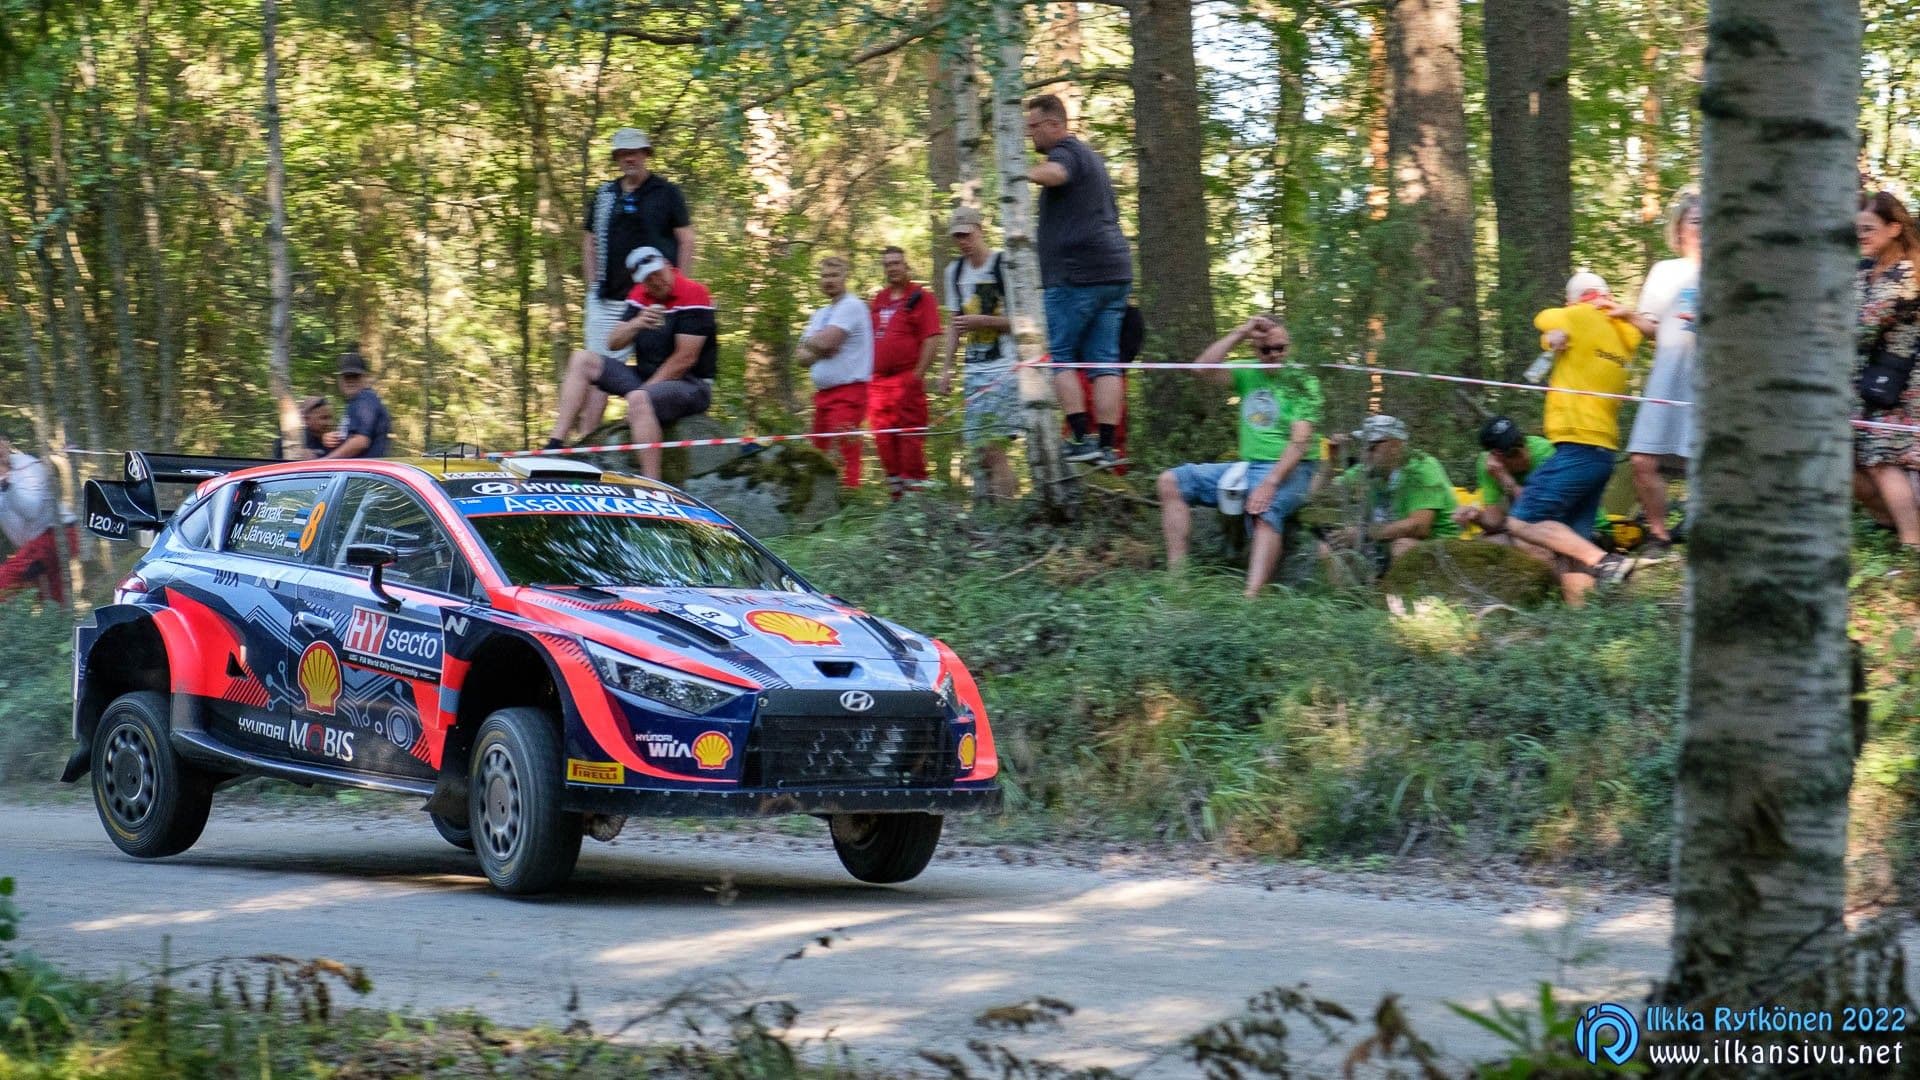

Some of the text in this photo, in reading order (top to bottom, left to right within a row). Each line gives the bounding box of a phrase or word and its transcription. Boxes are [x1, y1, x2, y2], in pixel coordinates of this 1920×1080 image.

[522, 482, 625, 498] HYUNDAI
[241, 500, 284, 521] O. Tänak
[230, 523, 285, 550] M. Järveoja
[299, 501, 327, 552] 8
[213, 568, 240, 587] WIA
[346, 609, 438, 659] HY secto
[238, 716, 355, 762] HYUNDAI MOBIS
[635, 733, 673, 742] HYUNDAI
[572, 763, 618, 780] PIRELLI
